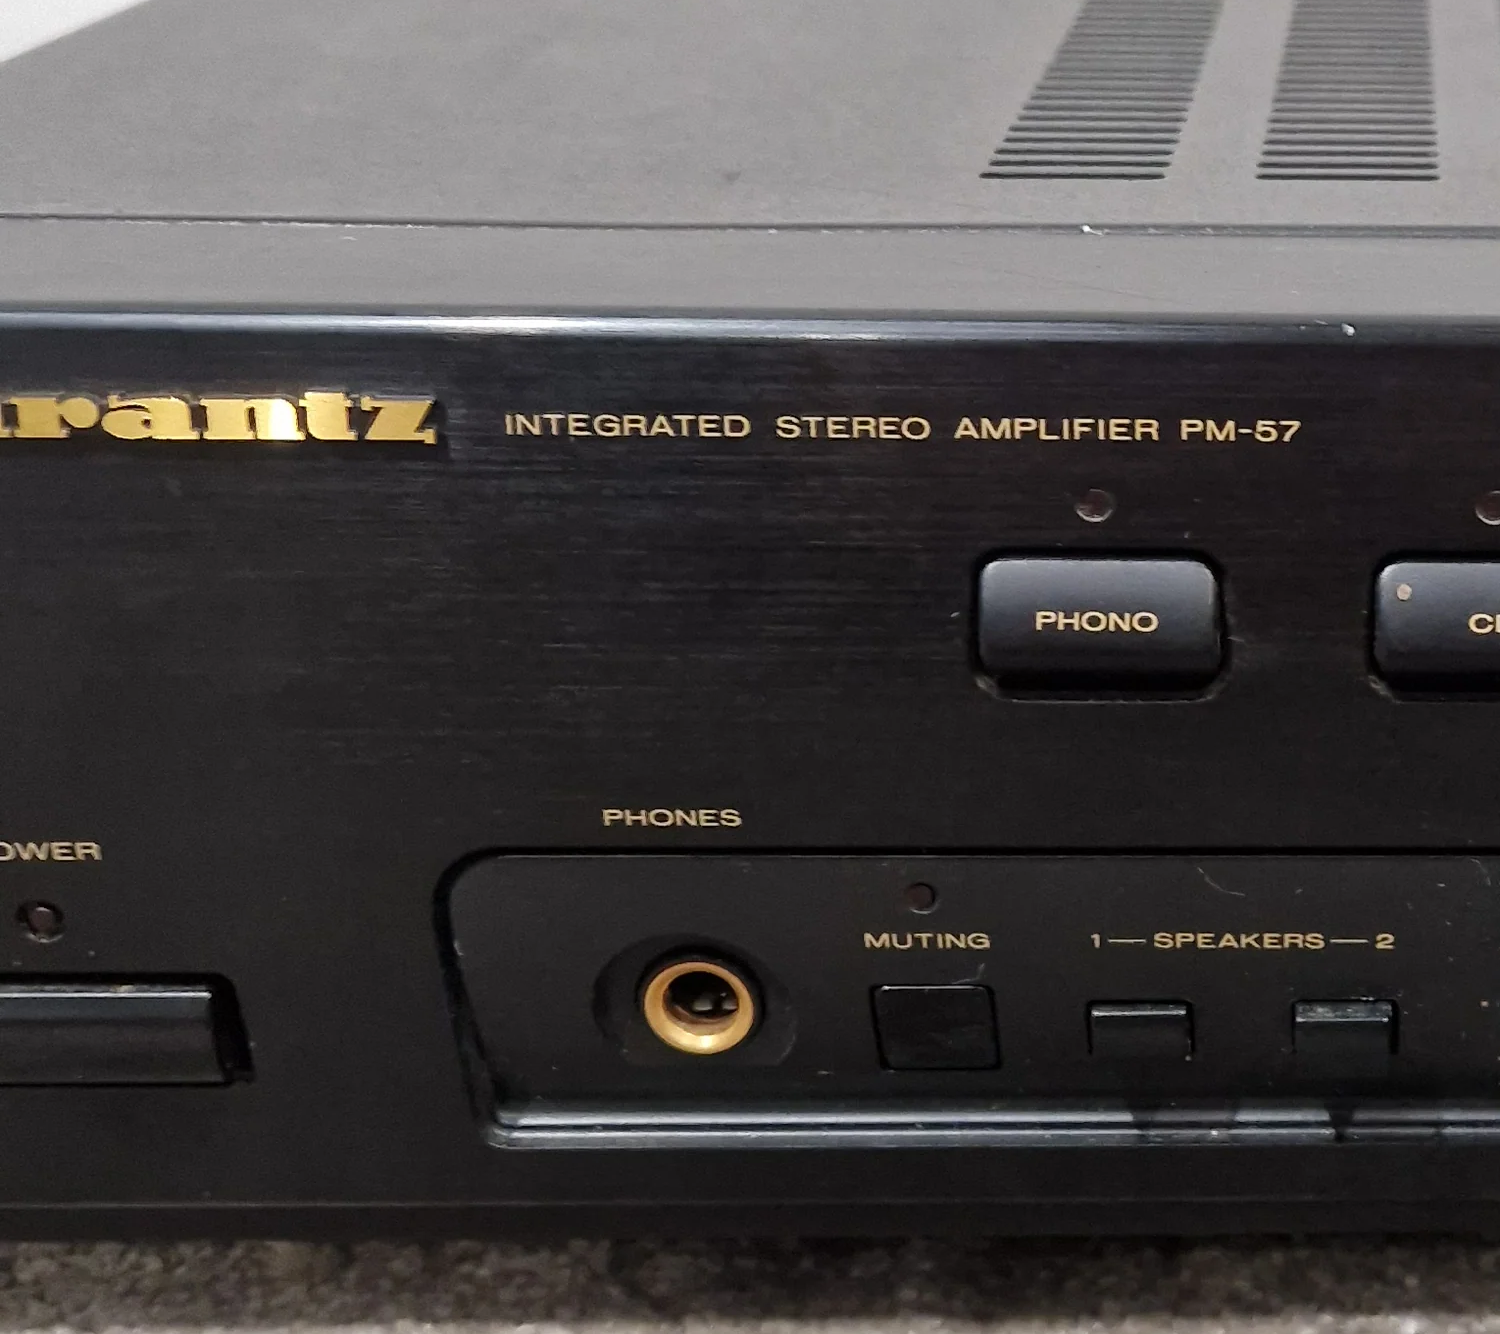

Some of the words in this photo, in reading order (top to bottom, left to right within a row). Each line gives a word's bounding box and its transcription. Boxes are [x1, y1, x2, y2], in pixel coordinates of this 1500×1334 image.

[0, 391, 436, 445] rantz
[504, 413, 752, 438] INTEGRATED
[775, 415, 932, 441] STEREO
[953, 416, 1160, 441] AMPLIFIER
[1180, 418, 1302, 443] PM-57
[1035, 610, 1159, 633] PHONO
[601, 808, 743, 827] PHONES
[863, 932, 991, 950] MUTING
[1153, 931, 1326, 950] SPEAKERS
[1375, 933, 1395, 950] 2
